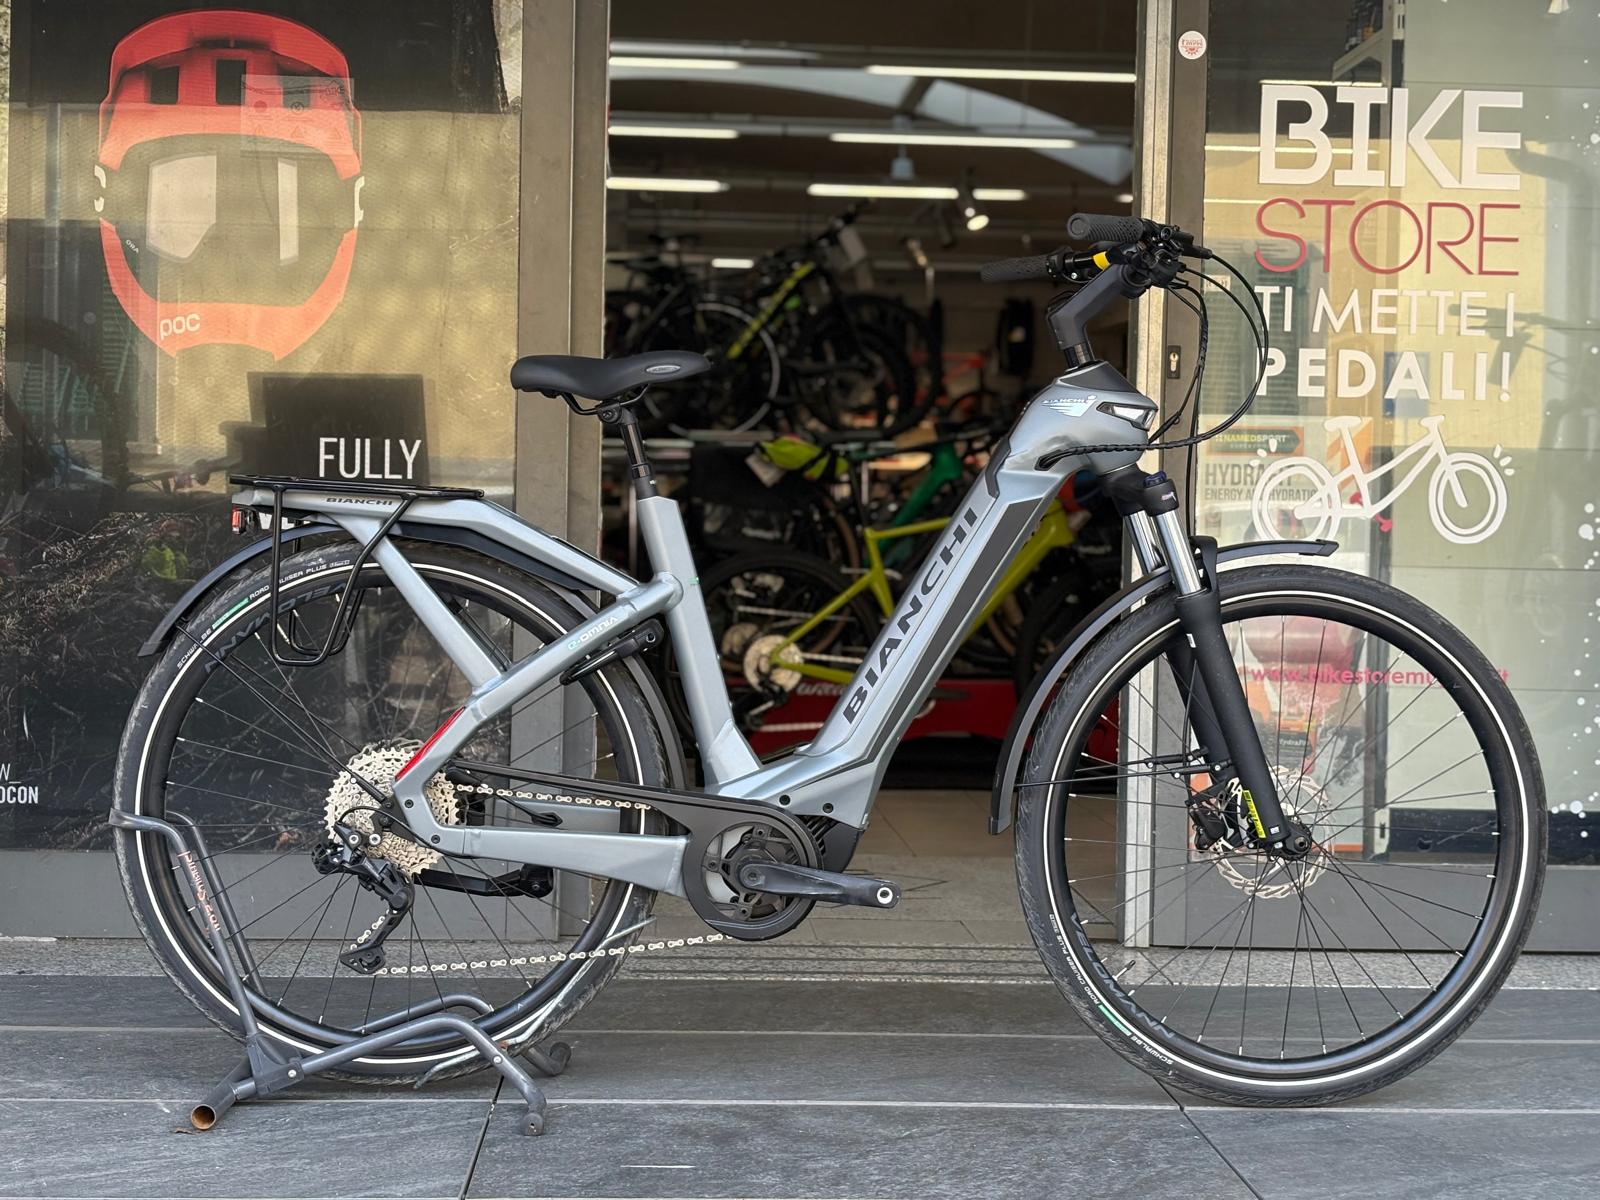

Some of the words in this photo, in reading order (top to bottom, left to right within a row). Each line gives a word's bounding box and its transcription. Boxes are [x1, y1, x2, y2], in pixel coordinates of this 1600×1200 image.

[1258, 84, 1523, 190] BIKE
[1254, 197, 1521, 276] STORE
[1254, 285, 1293, 332] TI
[1312, 287, 1488, 336] METTE
[1506, 292, 1515, 338] I
[1256, 348, 1511, 402] PEDALI!
[319, 437, 422, 479] FULLY
[326, 497, 393, 506] BIANCHI
[1204, 488, 1243, 500] ENERGY
[1269, 488, 1320, 501] HYDRATIO
[842, 507, 978, 724] BIANCHI
[1131, 1035, 1174, 1065] SCHWALBE
